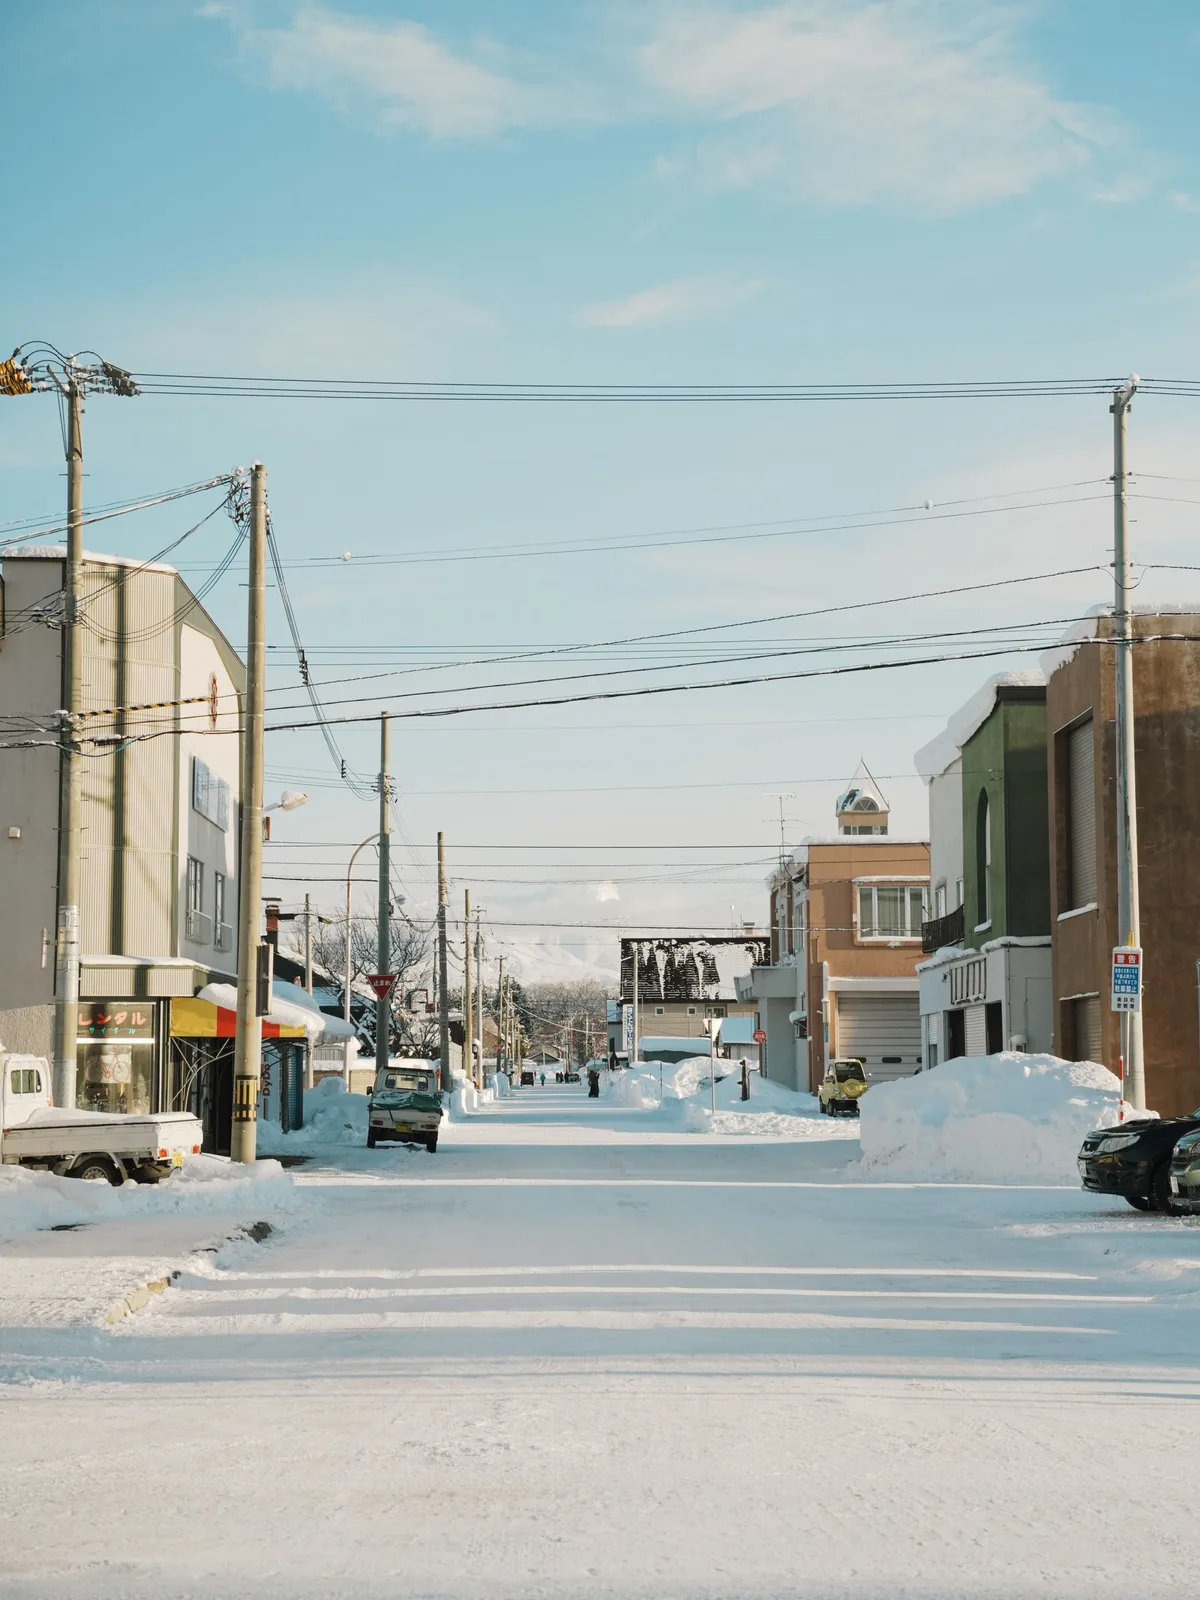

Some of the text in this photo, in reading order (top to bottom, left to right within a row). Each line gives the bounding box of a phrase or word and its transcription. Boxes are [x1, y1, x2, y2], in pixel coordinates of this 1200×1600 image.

[1117, 954, 1136, 964] 警告
[373, 979, 391, 987] 止まれ
[78, 1011, 147, 1026] レンタル
[89, 1026, 137, 1035] サイクル
[262, 1063, 273, 1097] DyDo
